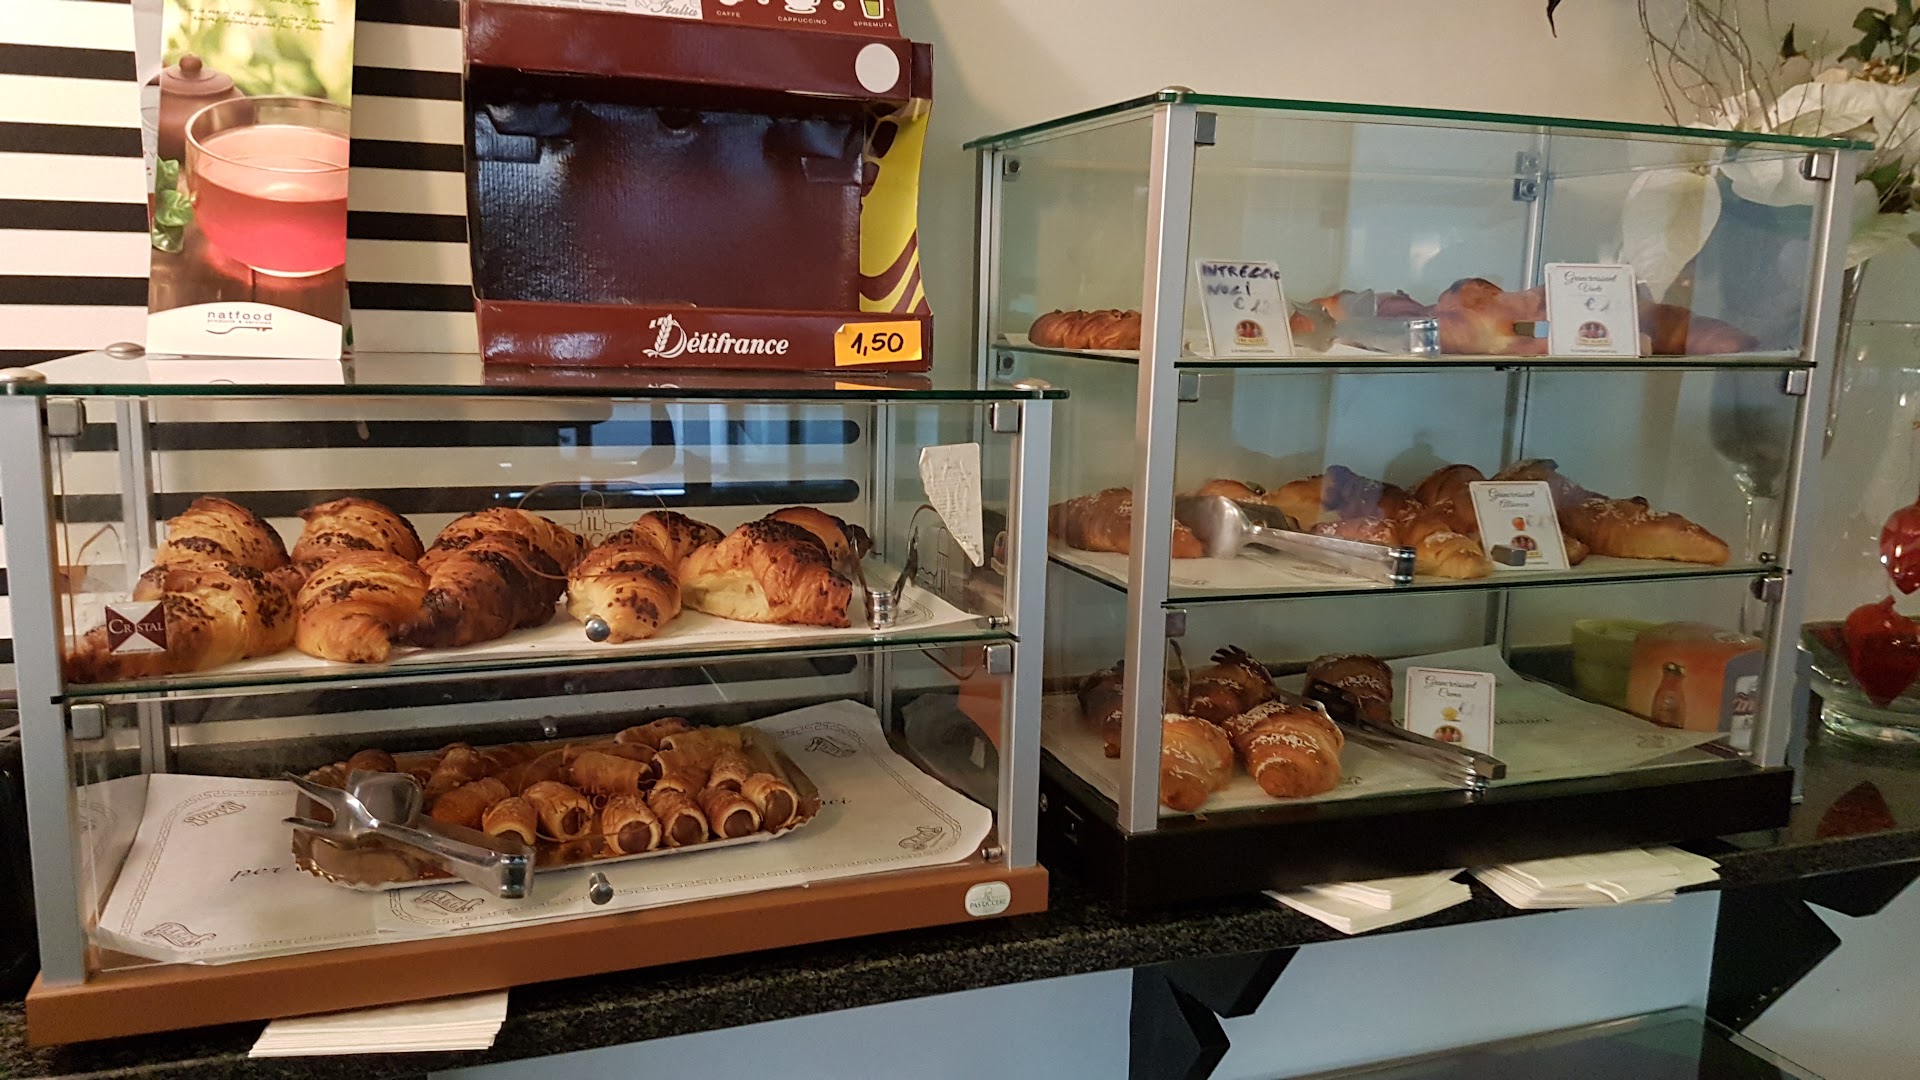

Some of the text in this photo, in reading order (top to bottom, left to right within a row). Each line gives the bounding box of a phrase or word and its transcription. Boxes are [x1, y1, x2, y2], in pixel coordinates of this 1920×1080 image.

[777, 15, 828, 25] CAPPUCCINO
[207, 311, 272, 321] natfood
[850, 332, 905, 357] 1,50
